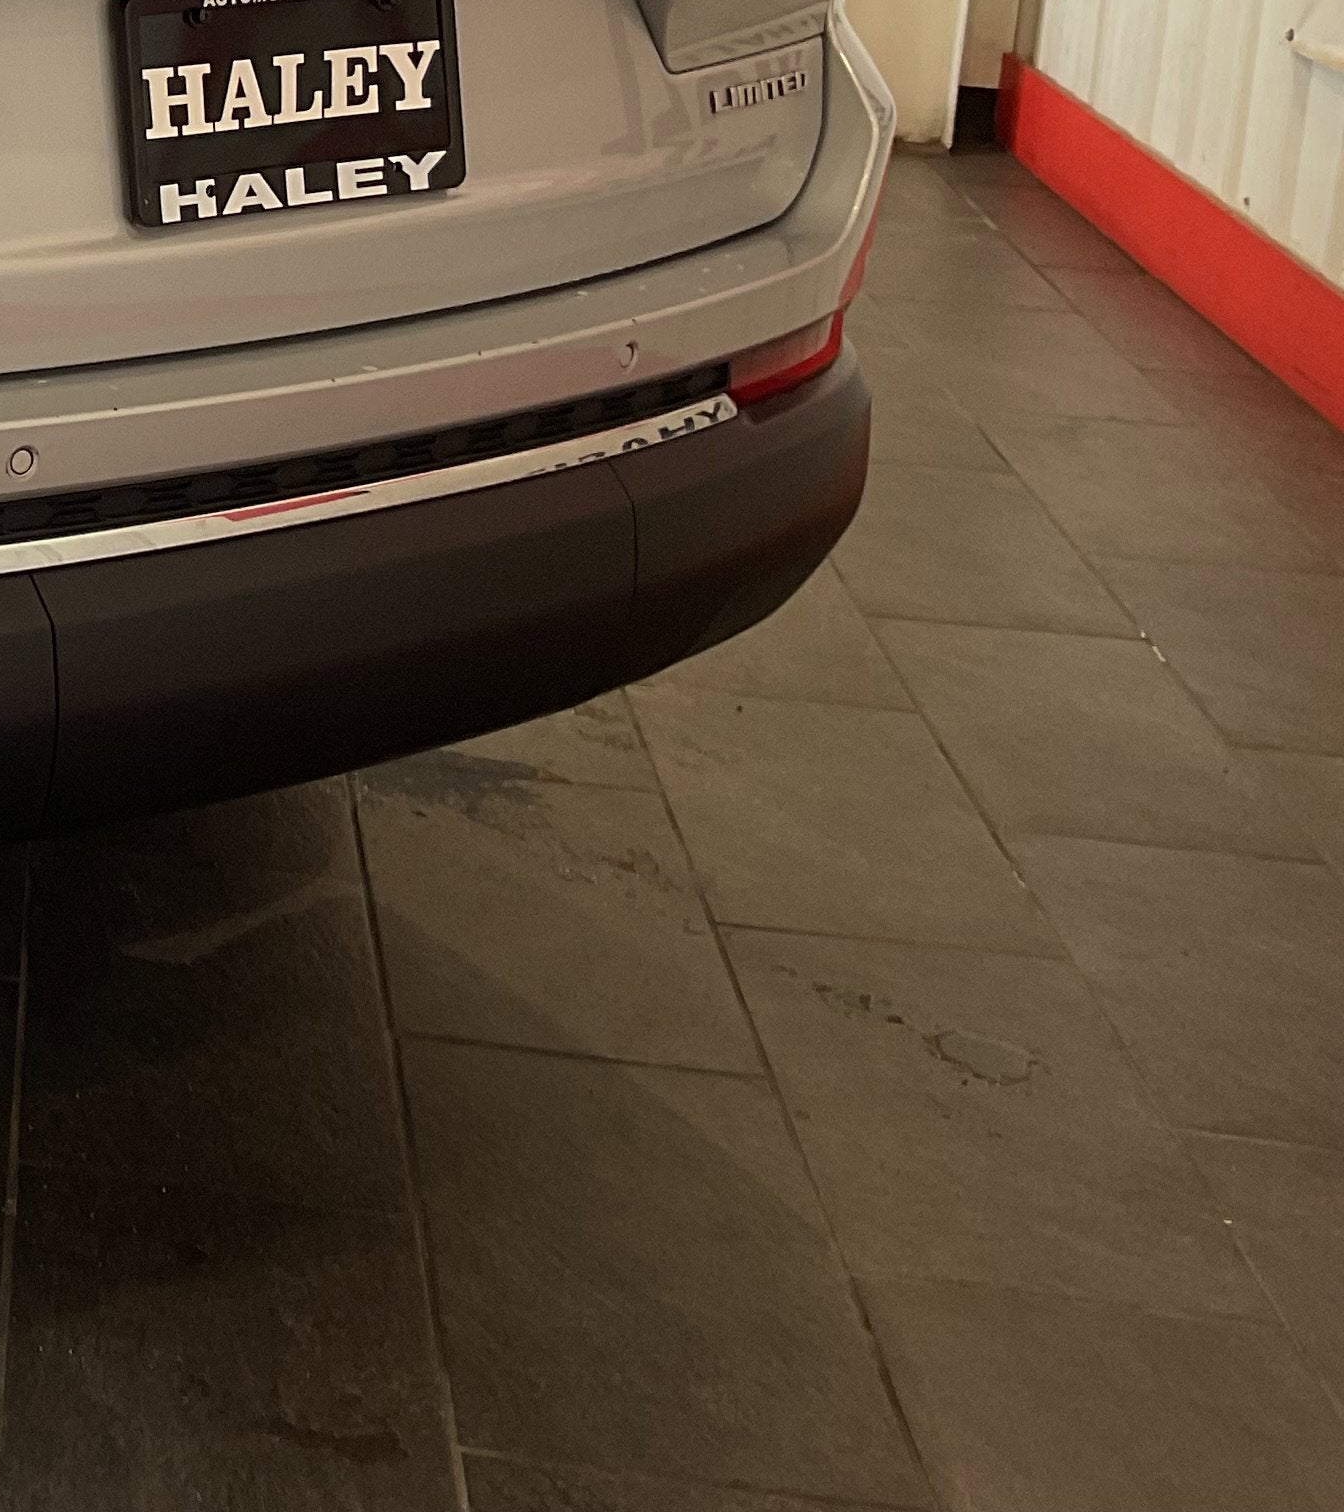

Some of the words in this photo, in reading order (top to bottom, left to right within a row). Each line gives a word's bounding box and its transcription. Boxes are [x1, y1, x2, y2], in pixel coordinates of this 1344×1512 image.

[142, 39, 440, 140] HALEY
[709, 71, 808, 114] LIMITED
[159, 150, 448, 224] HALEY
